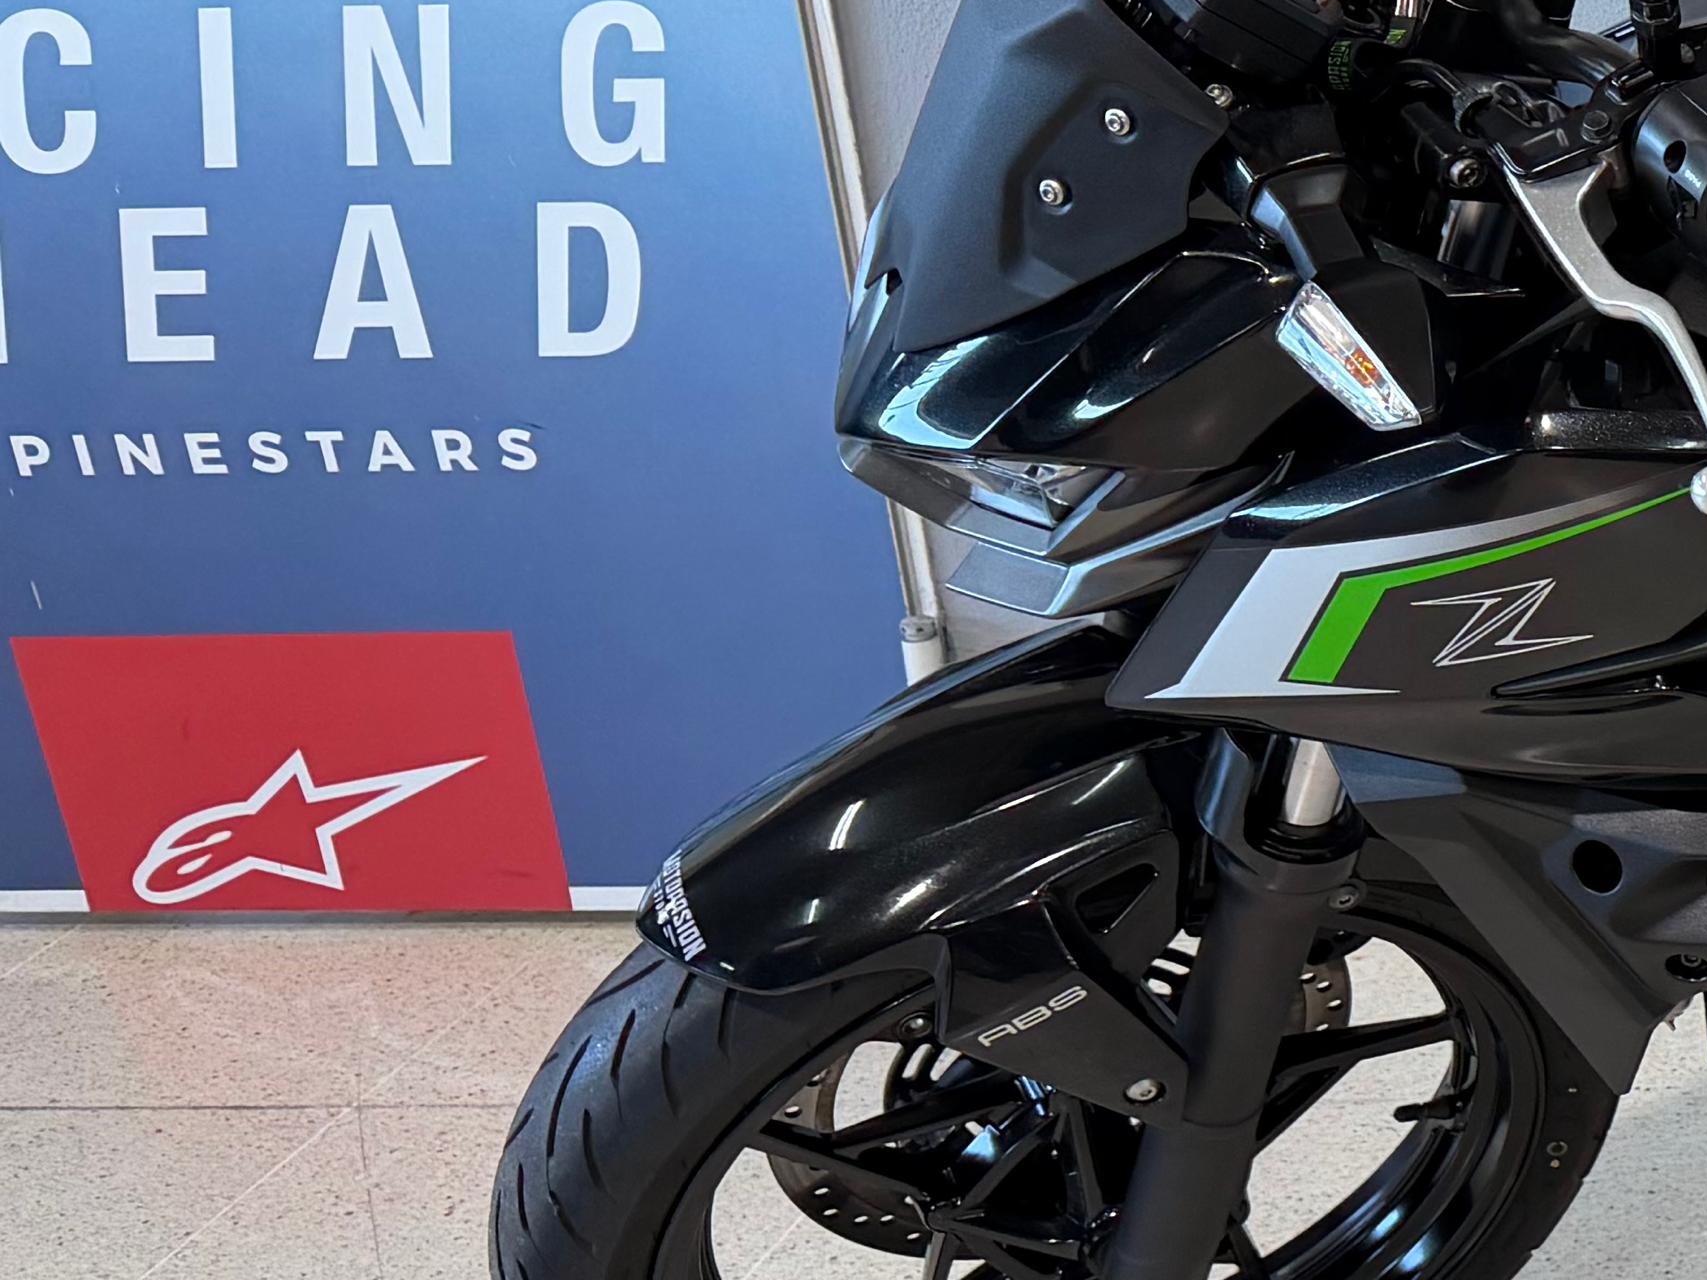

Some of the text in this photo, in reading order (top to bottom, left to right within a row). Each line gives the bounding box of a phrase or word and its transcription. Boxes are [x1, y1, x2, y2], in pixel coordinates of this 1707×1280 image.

[0, 0, 666, 175] CING
[0, 201, 642, 365] EAD
[8, 428, 540, 478] PINESTARS
[1410, 578, 1594, 667] Z
[978, 985, 1088, 1047] ABS
